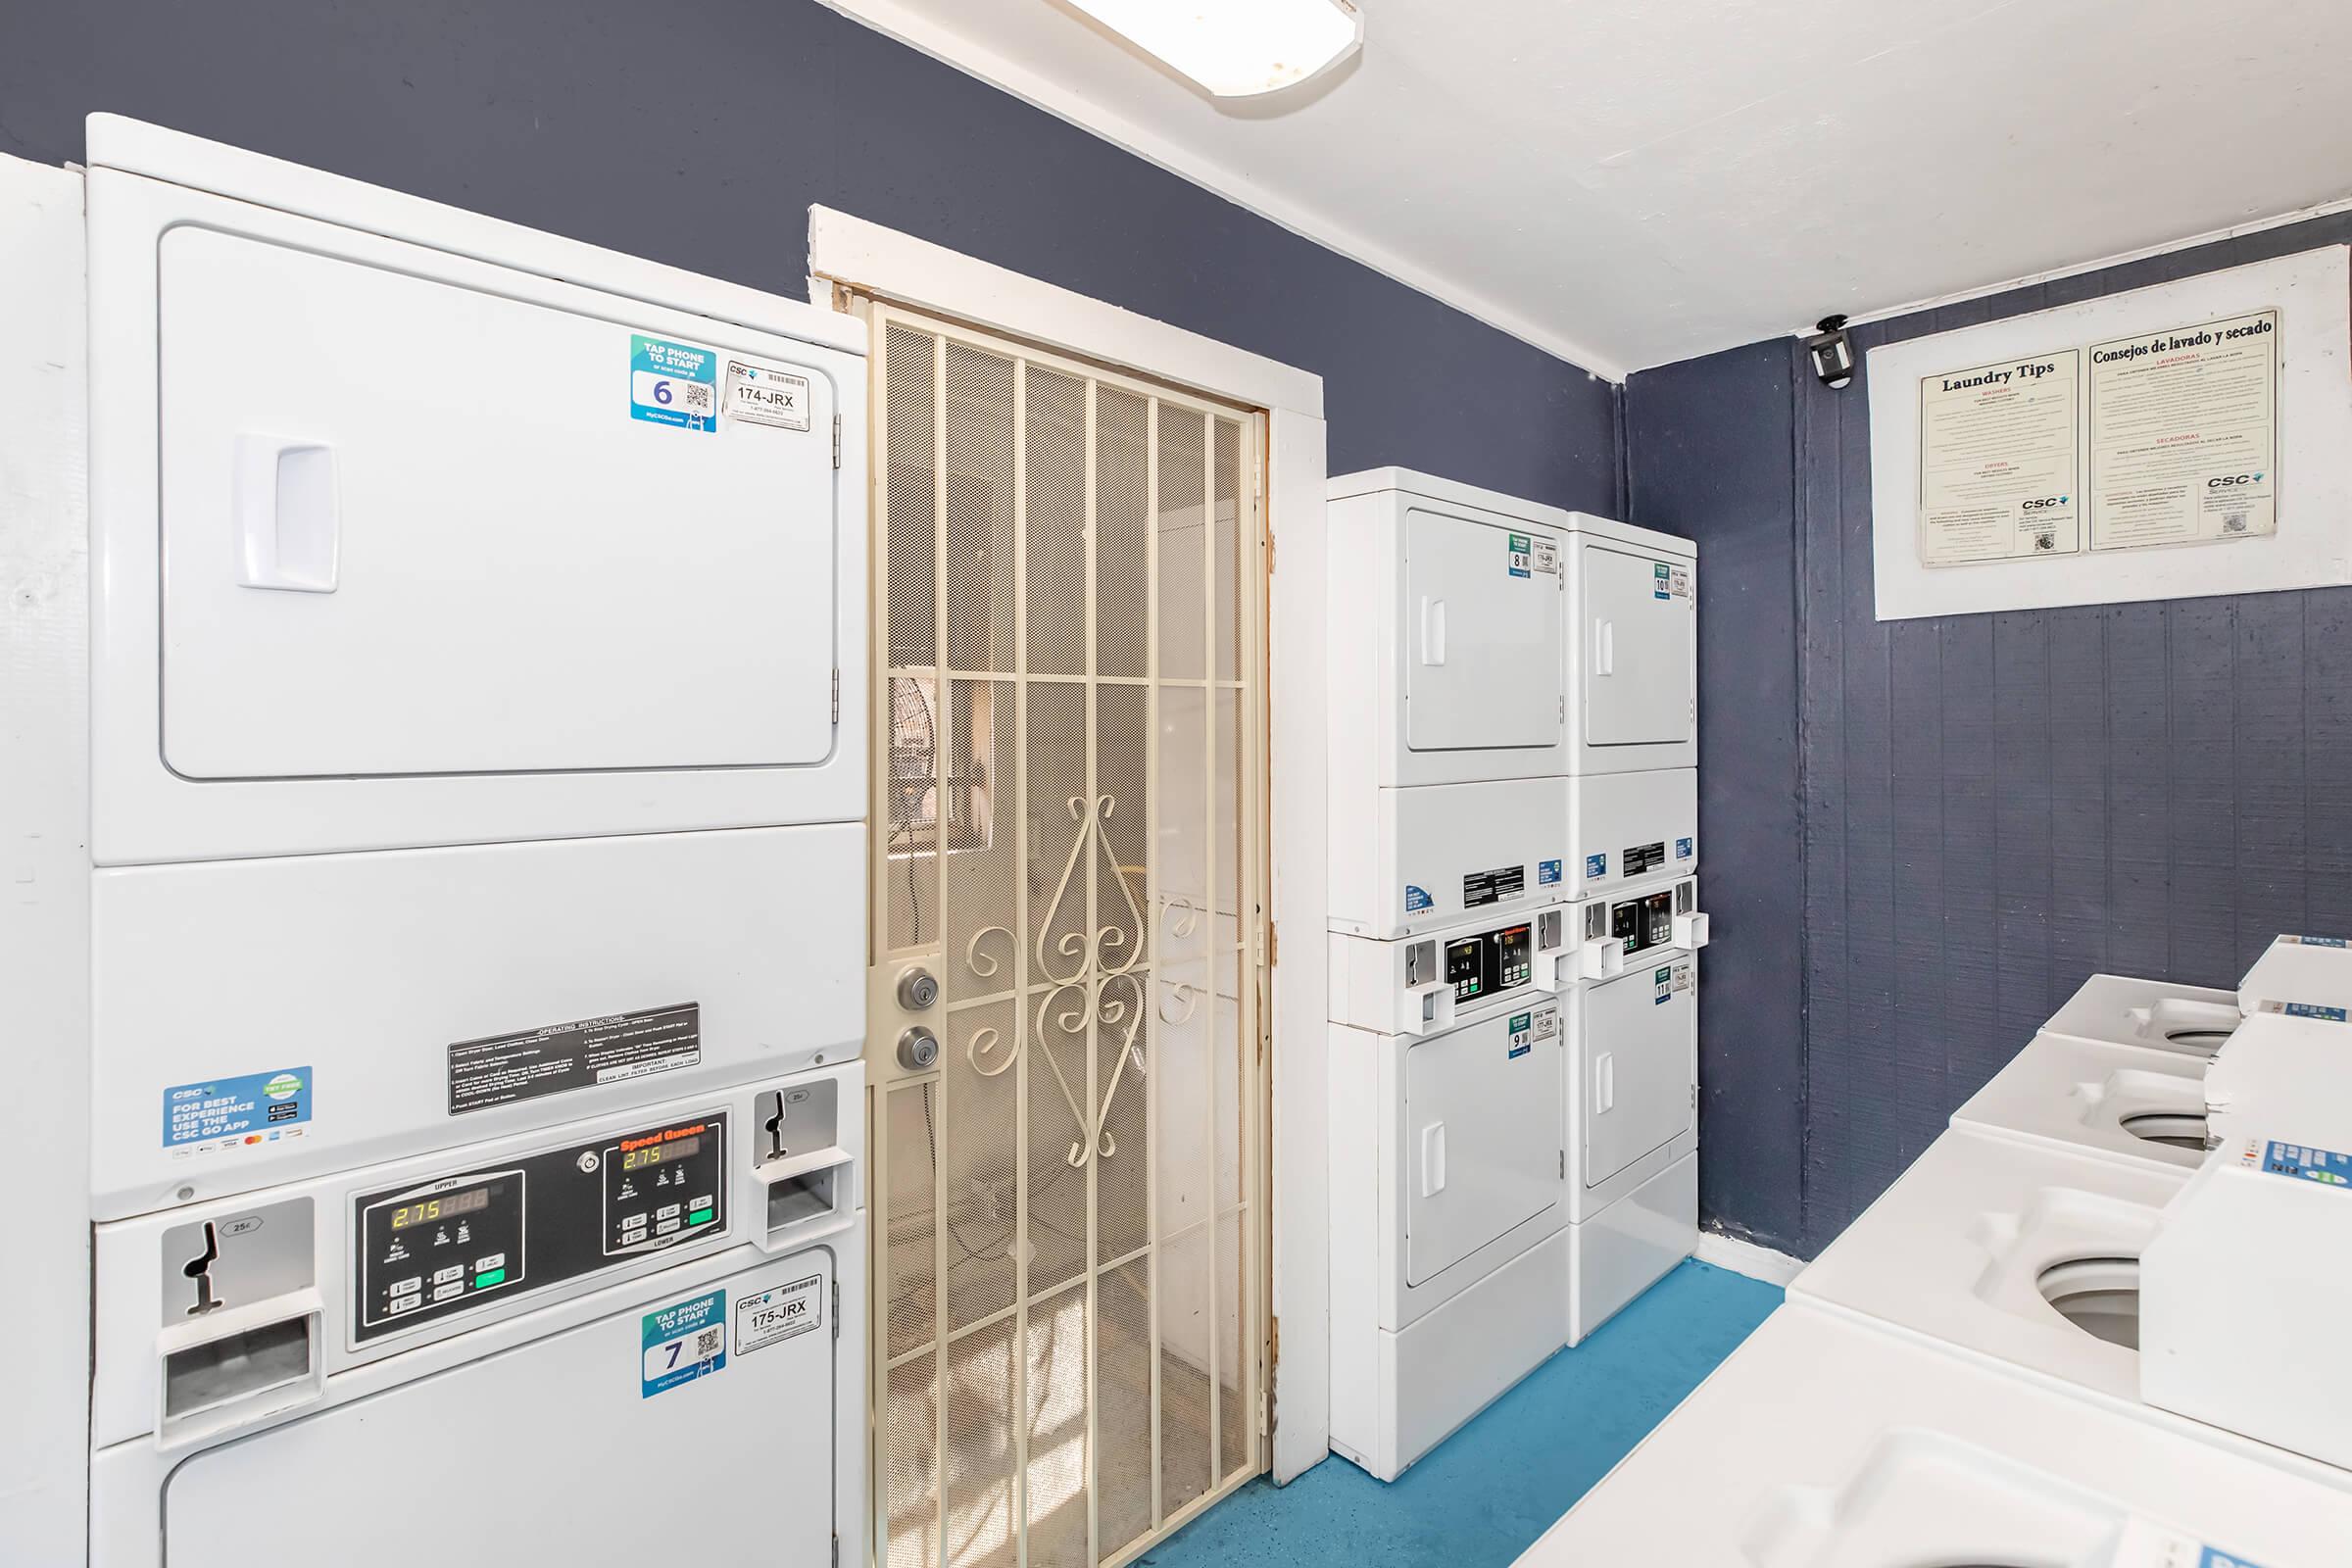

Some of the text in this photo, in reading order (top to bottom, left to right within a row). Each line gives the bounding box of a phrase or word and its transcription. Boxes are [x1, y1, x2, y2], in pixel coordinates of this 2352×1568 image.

[2093, 320, 2272, 365] Consejos de lavado y secado
[644, 343, 705, 364] TAP PHONE
[649, 353, 700, 370] TO START
[2157, 353, 2200, 365] LAVADORAS
[730, 366, 747, 375] CSC
[1942, 363, 2055, 392] Laundry Tips
[654, 381, 672, 405] 6
[738, 387, 793, 408] 174-JRX
[1982, 387, 2011, 396] WASHERS
[2156, 433, 2200, 444] SECADORAS
[2208, 474, 2249, 488] CSC
[2023, 498, 2057, 509] CSC
[1514, 554, 1520, 566] 8
[1656, 579, 1664, 591] 10
[1514, 1034, 1520, 1048] 9
[172, 1089, 203, 1100] CSC
[172, 1096, 237, 1114] FOR BEST
[172, 1102, 255, 1123] EXPERIENCE
[172, 1115, 228, 1132] USE THE
[172, 1120, 250, 1141] CSC GO APP
[620, 1125, 705, 1152] Speed Queen
[623, 1147, 660, 1169] 2.75
[435, 1180, 457, 1191] UPPER
[393, 1200, 439, 1228] 2.75
[655, 1237, 673, 1247] LOWER
[656, 1298, 713, 1324] TAP PHONE
[740, 1298, 761, 1309] CSC
[660, 1307, 710, 1331] TO START
[752, 1299, 806, 1327] 175-JRX
[665, 1341, 683, 1370] 7
